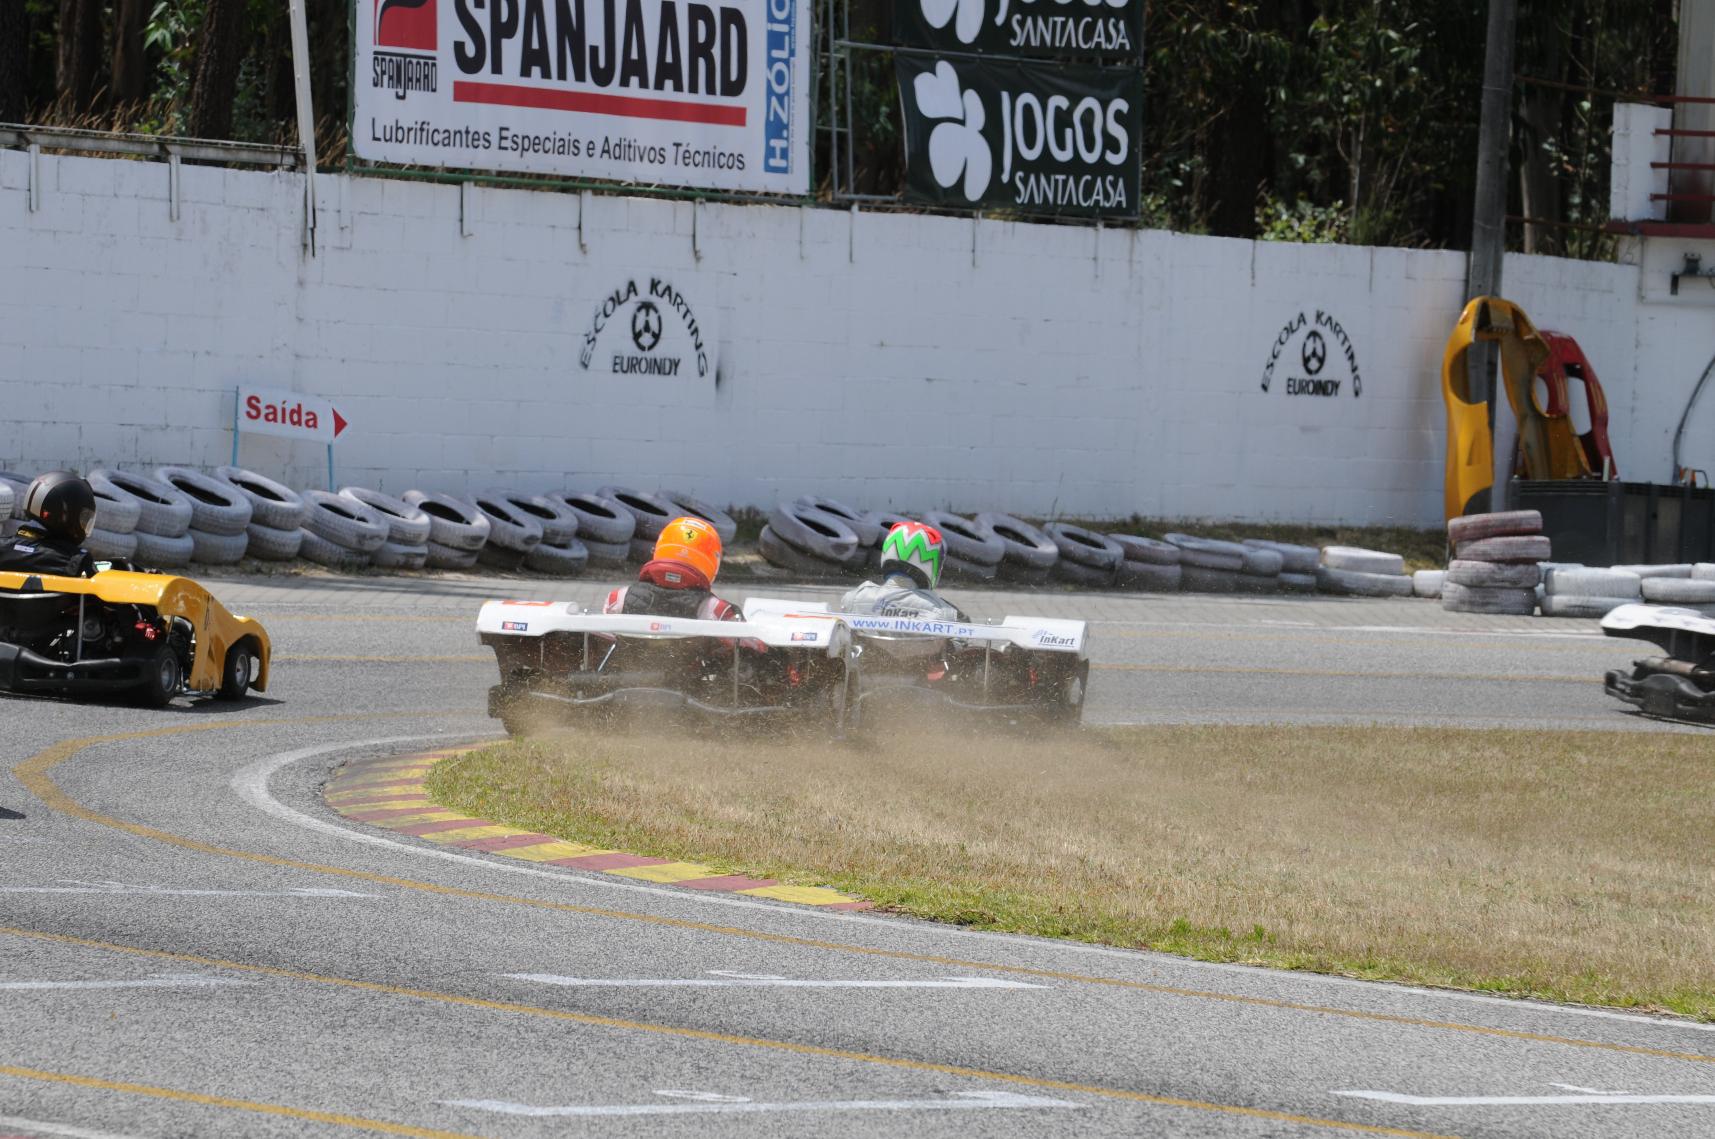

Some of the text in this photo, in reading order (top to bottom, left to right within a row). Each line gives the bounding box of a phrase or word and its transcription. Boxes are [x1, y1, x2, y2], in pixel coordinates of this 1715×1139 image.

[453, 0, 748, 97] SPANJAARD
[1009, 14, 1130, 50] SANTACASA
[373, 51, 438, 101] SPANJAARD
[371, 117, 746, 171] Lubrificantes Especiais e Aditivos Técnicos
[1001, 91, 1130, 184] JOGOS
[1015, 171, 1126, 208] SANTACASA
[578, 277, 709, 378] ESCOLA KARTING
[611, 354, 682, 377] EUROINDY
[1286, 377, 1342, 397] EUROINDY
[245, 395, 319, 430] Saída
